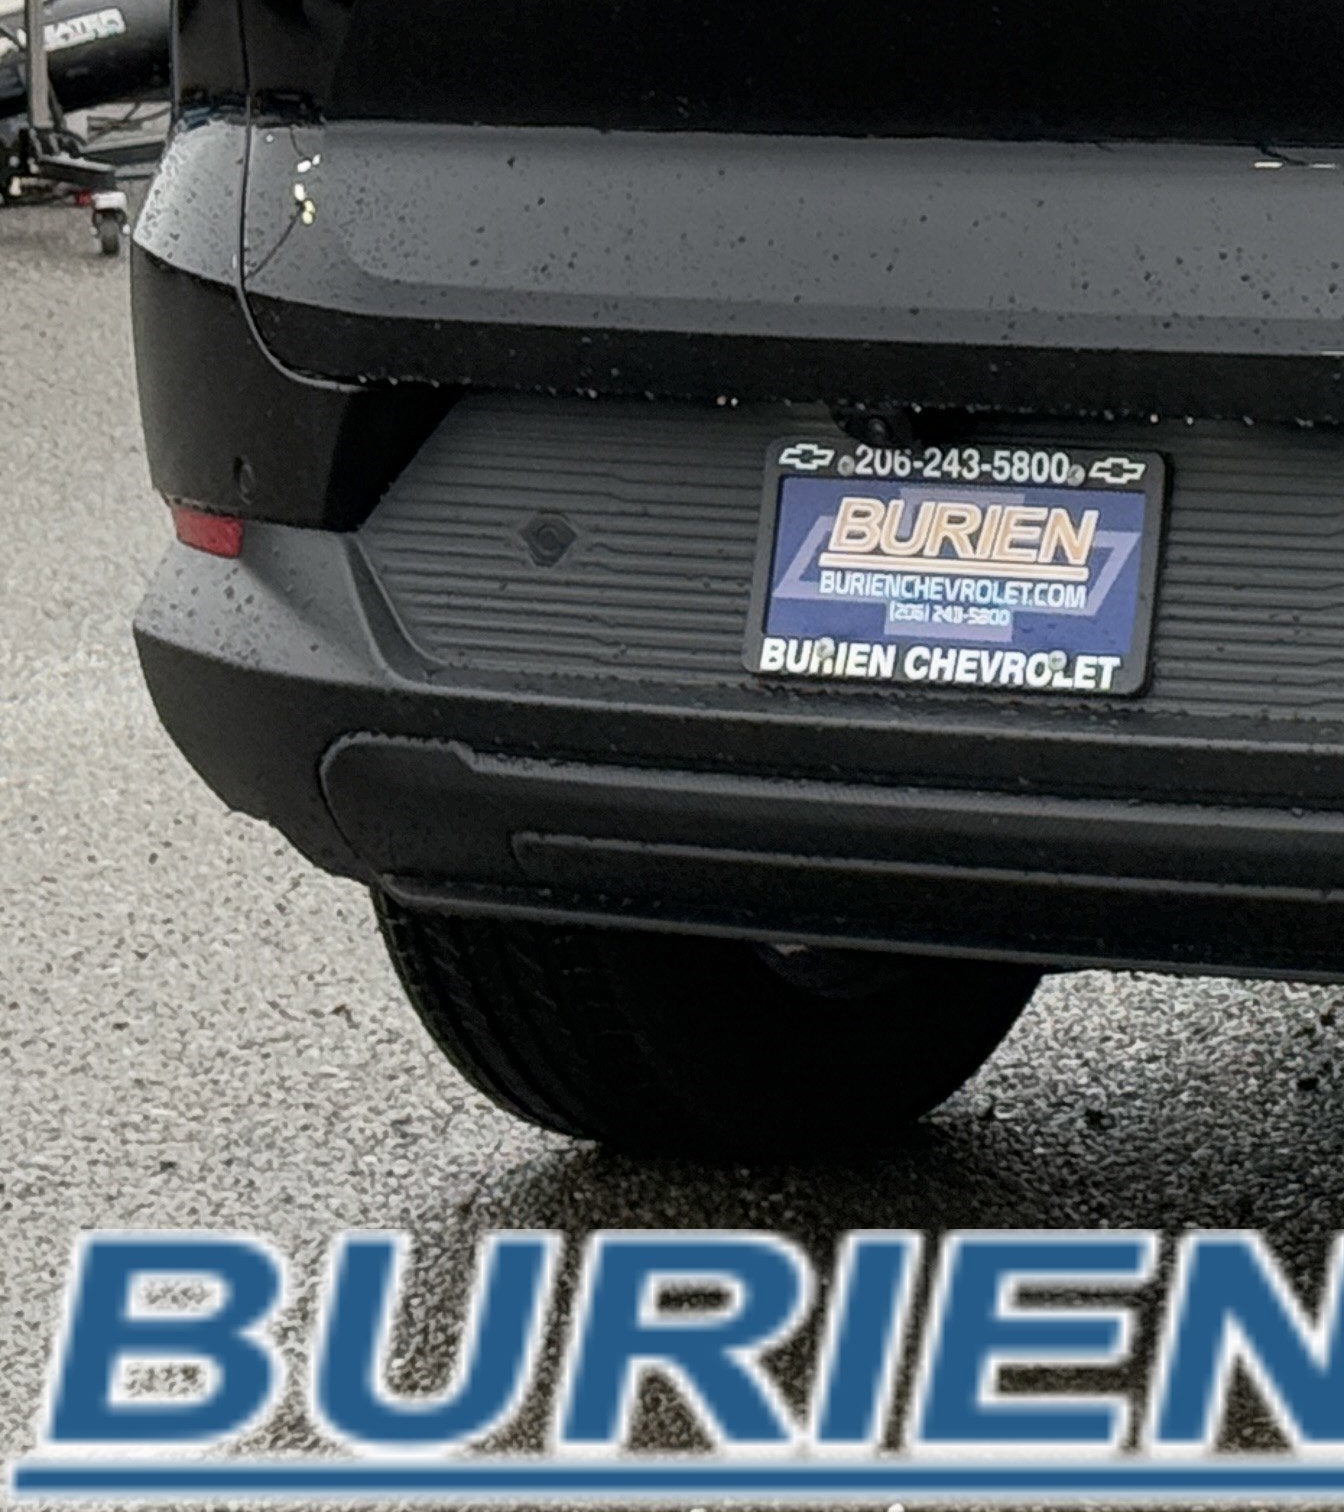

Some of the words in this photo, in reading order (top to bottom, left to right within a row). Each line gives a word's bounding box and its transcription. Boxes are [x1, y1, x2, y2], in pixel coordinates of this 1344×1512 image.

[854, 446, 1070, 485] 206-243-5800
[827, 496, 1099, 565] BURIEN
[819, 569, 1087, 609] BURIENCHEVROLET.COM
[760, 637, 896, 679] BURIEN
